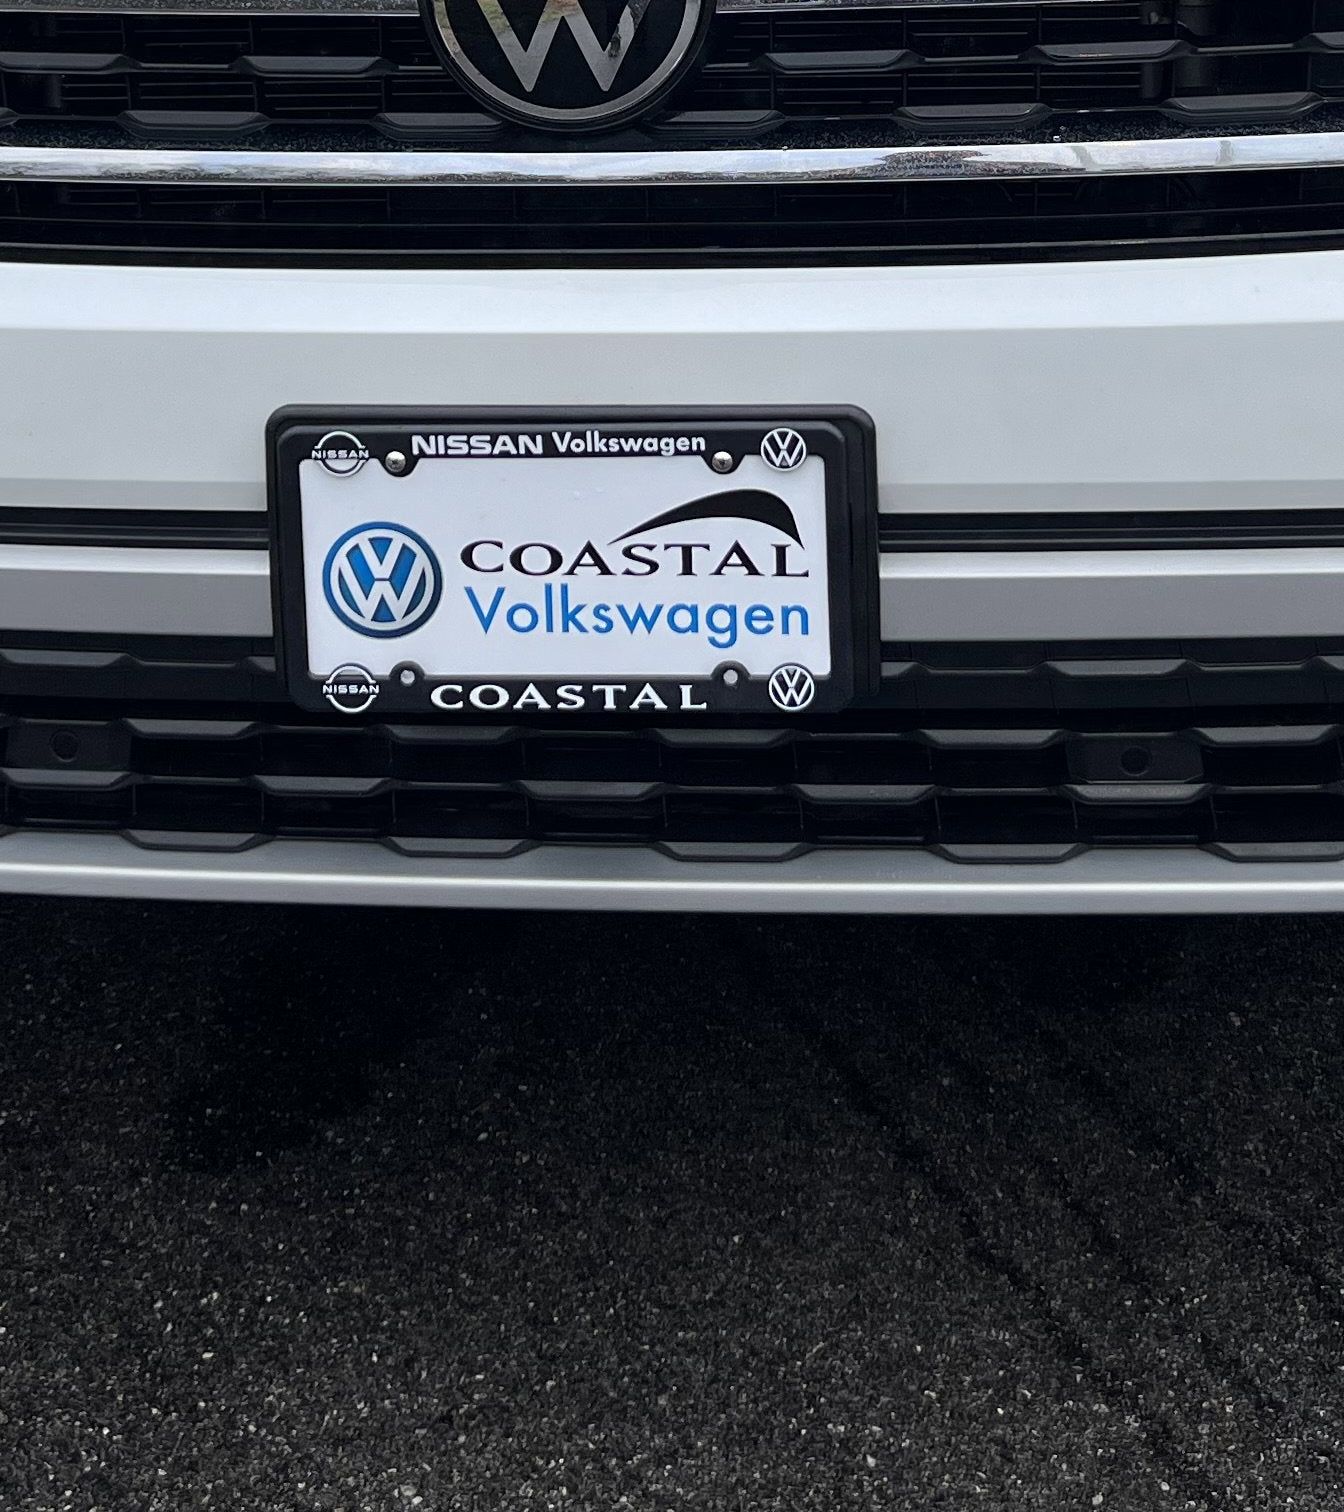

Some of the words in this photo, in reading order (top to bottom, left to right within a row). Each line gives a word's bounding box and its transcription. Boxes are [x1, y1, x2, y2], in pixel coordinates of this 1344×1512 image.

[311, 449, 369, 459] NISSAN
[411, 434, 543, 456] NISSAN
[552, 431, 706, 457] Volkswagen
[459, 539, 810, 577] COASTAL
[463, 583, 810, 649] Volkswagen
[322, 684, 380, 695] NISSAN
[430, 682, 708, 711] COASTAL
